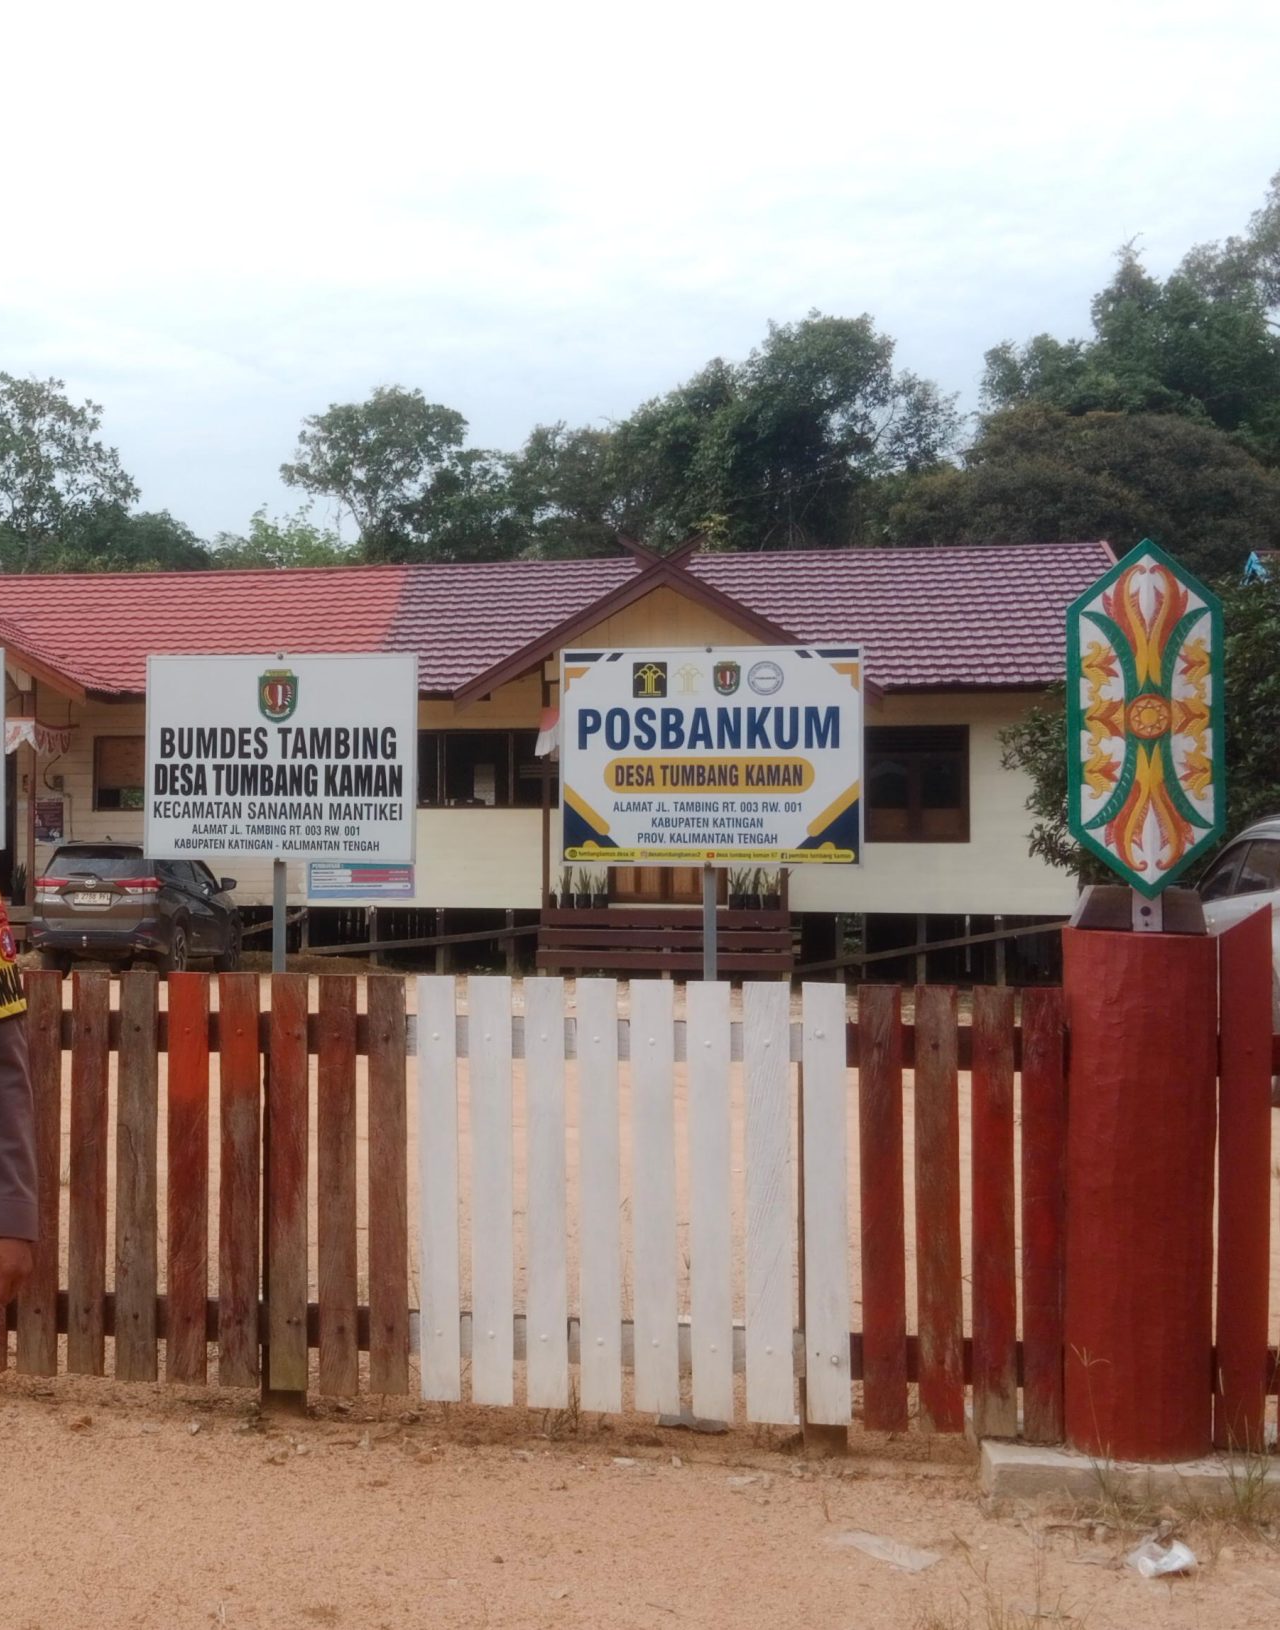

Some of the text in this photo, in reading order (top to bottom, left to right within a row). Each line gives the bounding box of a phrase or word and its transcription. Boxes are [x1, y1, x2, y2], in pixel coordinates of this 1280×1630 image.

[578, 706, 841, 751] POSBANKUM
[160, 727, 397, 761] BUMDES TAMBING
[154, 764, 403, 798] DESA TUMBANG KAMAN
[615, 764, 803, 787] DESA TUMBANG KAMAN
[153, 801, 403, 821] KECAMATAN SANAMAN MANTIKEI
[613, 802, 802, 813] ALAMAT JL. TAMBING RT. 003 RW. 001
[192, 824, 228, 835] ALAMAT
[230, 824, 243, 836] JL.
[246, 825, 287, 836] TAMBING
[305, 825, 322, 836] 003
[344, 825, 360, 837] 001
[651, 817, 764, 829] KABUPATEN KATINGAN
[174, 839, 226, 850] KABUPATEN
[228, 839, 273, 850] KATINGAN
[282, 839, 339, 851] KALIMANTAN
[343, 840, 380, 852] TENGAH
[637, 833, 778, 845] PROV. KALIMANTAN TENGAH
